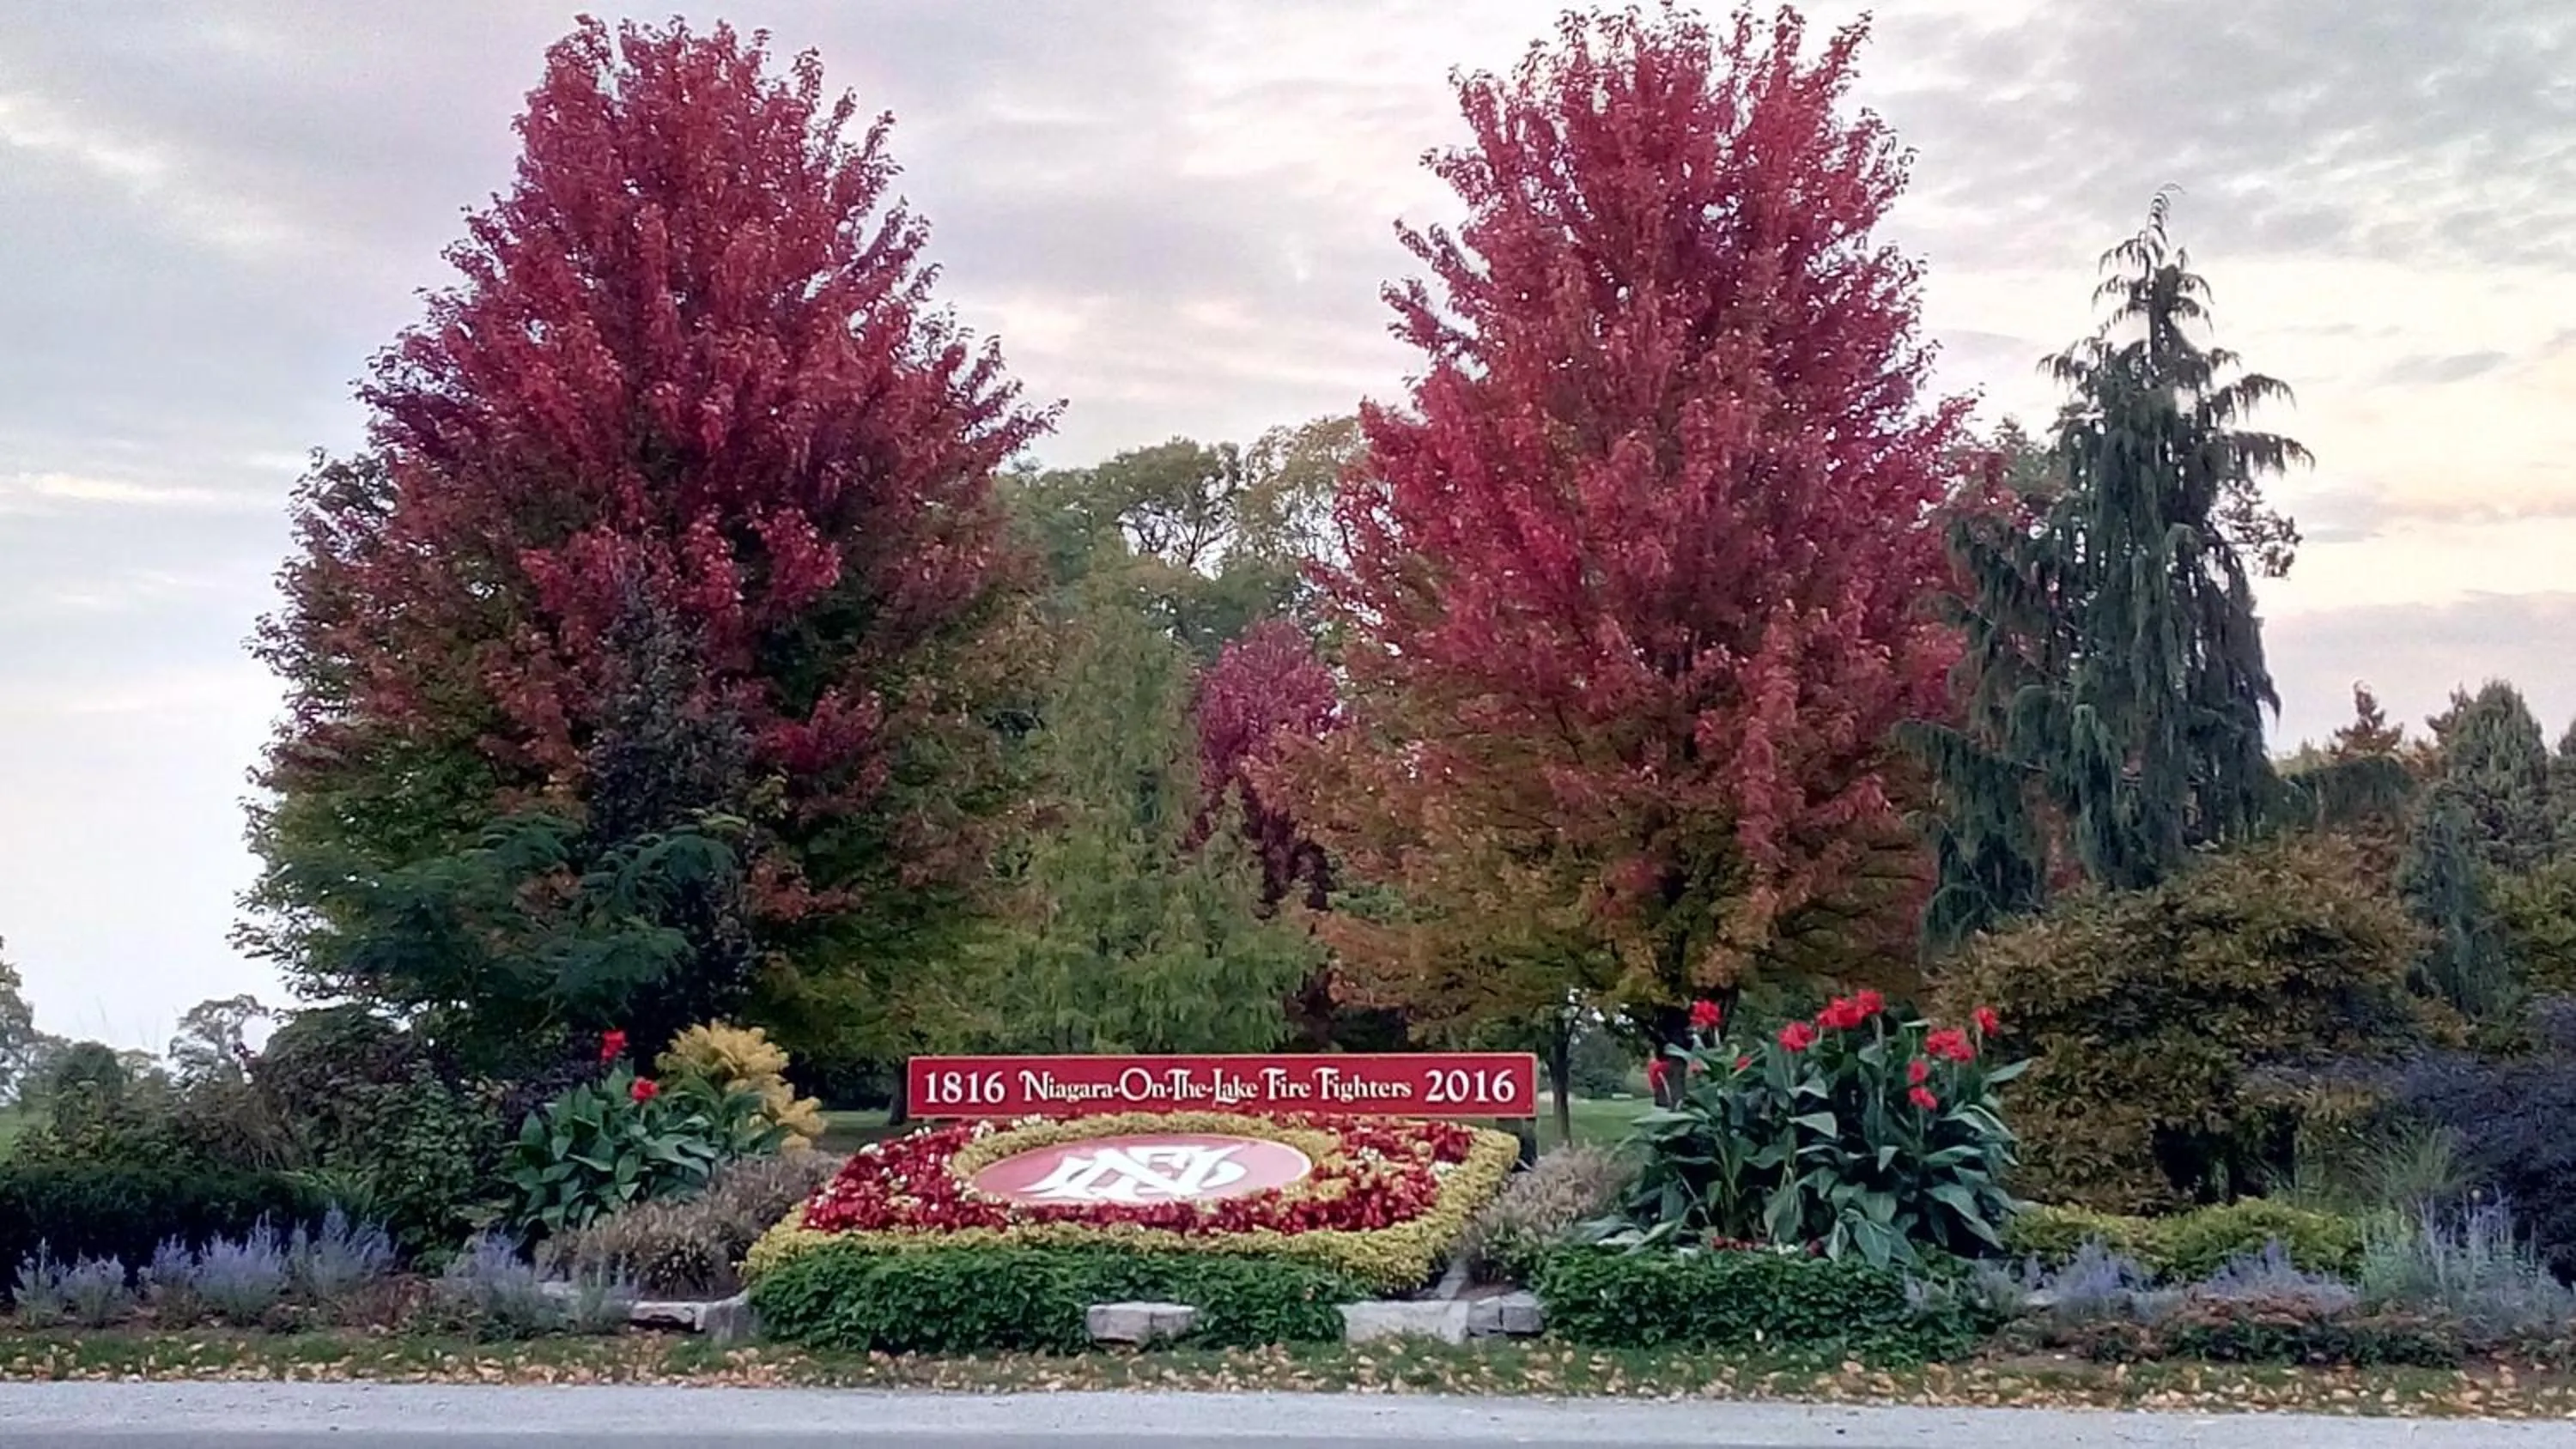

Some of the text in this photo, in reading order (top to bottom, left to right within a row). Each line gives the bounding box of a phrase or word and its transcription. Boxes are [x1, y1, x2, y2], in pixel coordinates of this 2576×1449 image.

[924, 1067, 1516, 1104] 1816 Niagara-On-The-Lake Fire Fighters 2016
